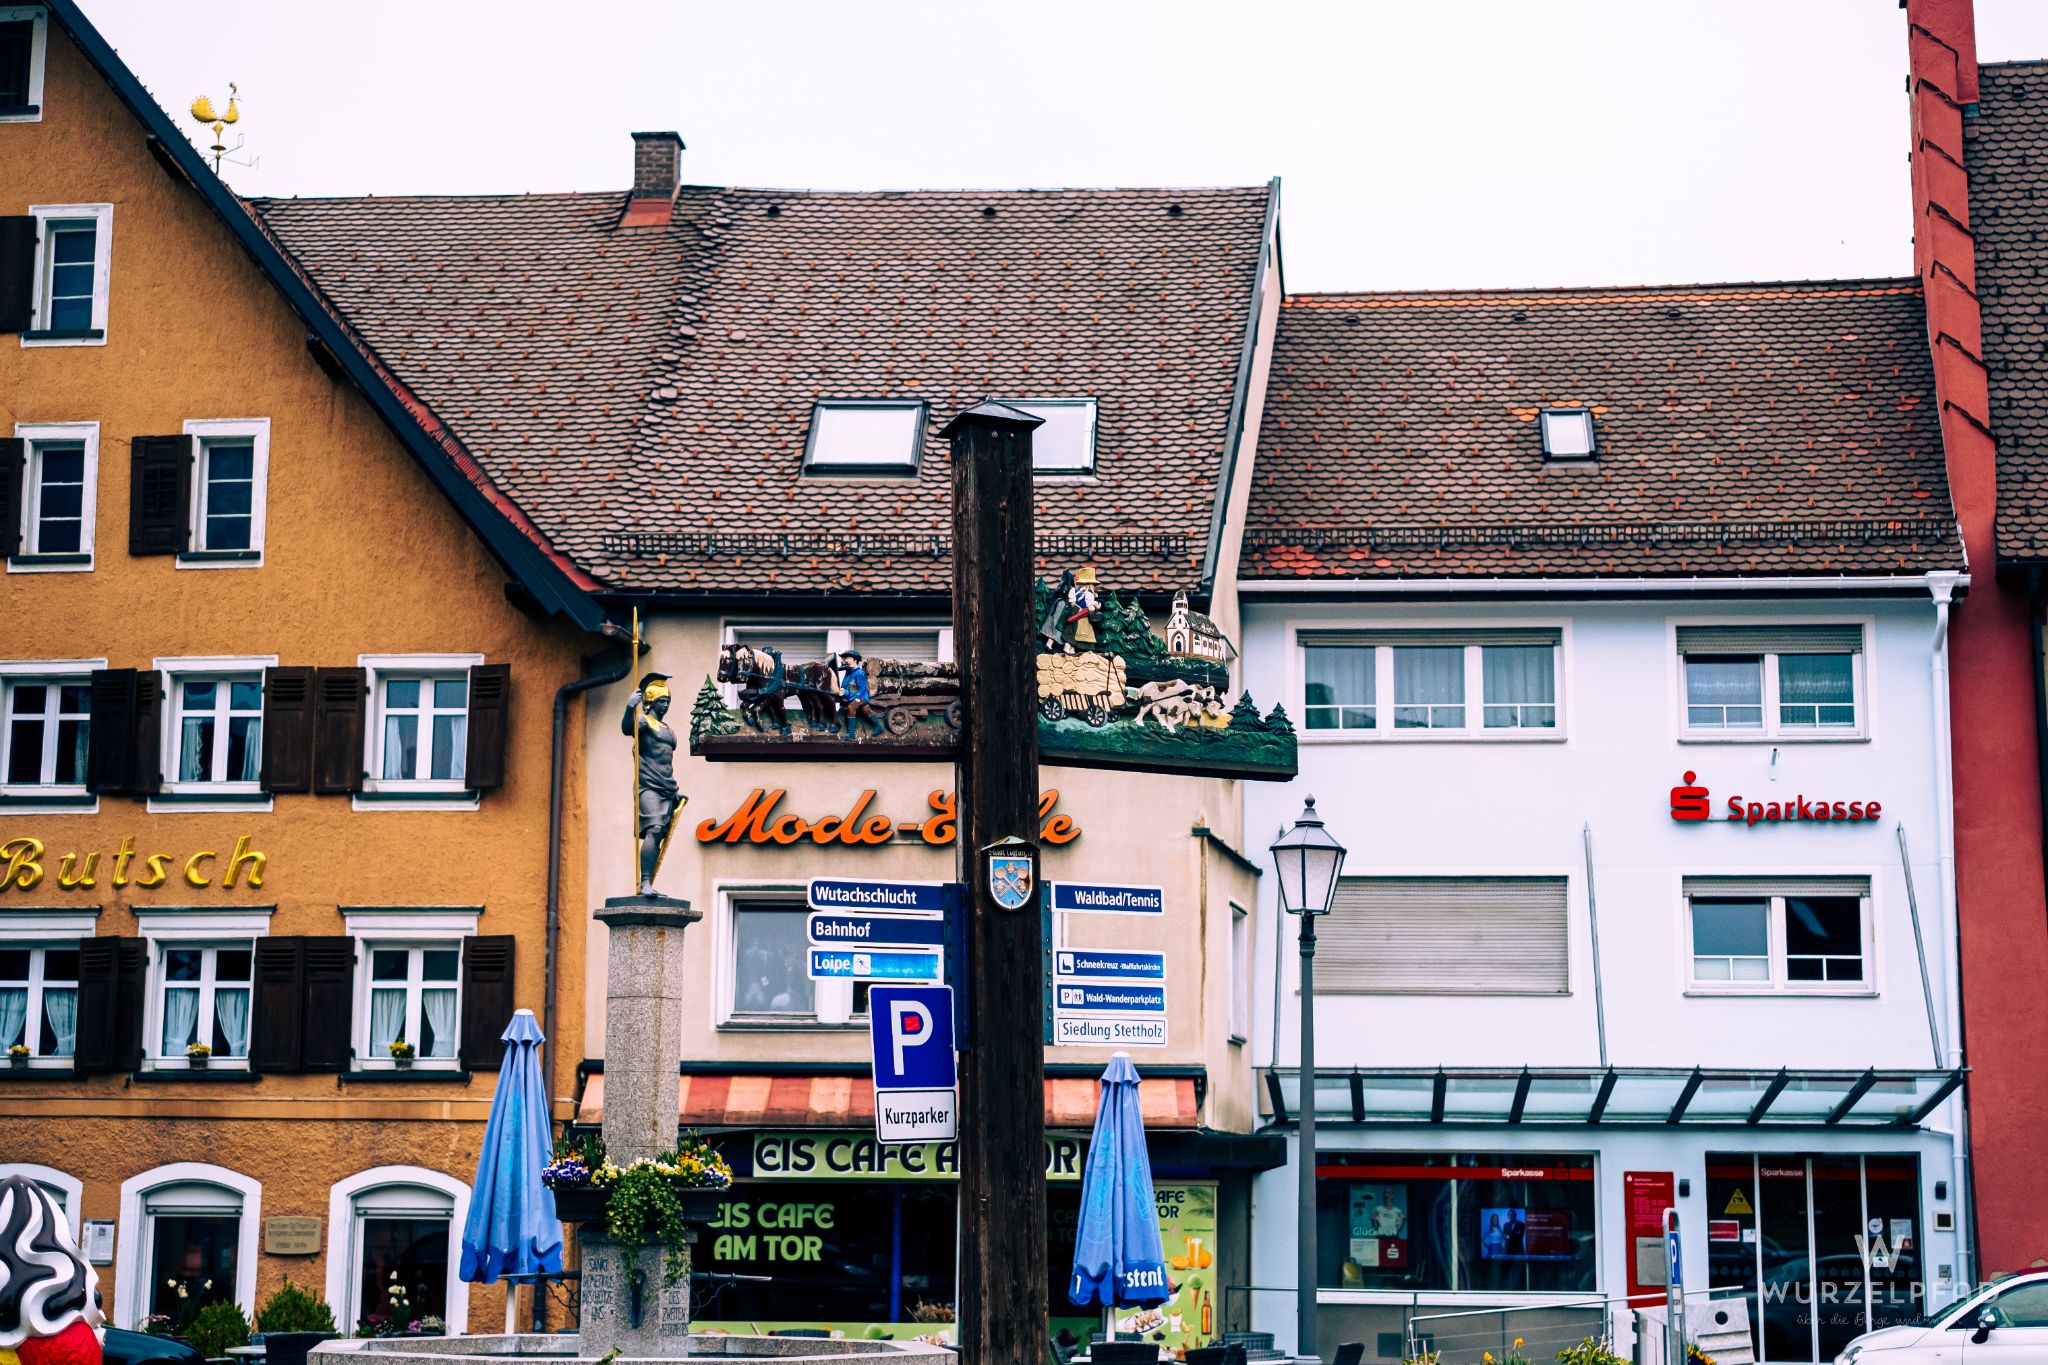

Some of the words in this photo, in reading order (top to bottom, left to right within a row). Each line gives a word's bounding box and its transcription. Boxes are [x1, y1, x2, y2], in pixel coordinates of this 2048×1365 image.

[1727, 794, 1881, 827] Sparkasse
[0, 835, 267, 892] Butsch
[815, 886, 917, 905] Wutachschlucht
[1074, 890, 1160, 908] Waldbad/Tennis
[815, 921, 871, 938] Bahnhof
[814, 955, 851, 973] Loipe
[1076, 959, 1119, 970] Schneekreuz
[1085, 993, 1161, 1005] Wald-Wanderparkplatz
[889, 999, 934, 1076] P
[1062, 1022, 1111, 1040] Siedlung
[1114, 1023, 1163, 1038] Stettholz
[884, 1106, 949, 1128] Kurzparker
[755, 1137, 817, 1173] EIS
[825, 1138, 928, 1174] CAFE
[935, 1140, 961, 1174] A
[1502, 1168, 1544, 1177] Sparkasse
[1760, 1168, 1804, 1177] Sparkasse
[1154, 1190, 1185, 1204] AFE
[757, 1203, 834, 1229] CAFE
[1156, 1205, 1179, 1218] OR
[713, 1234, 757, 1260] AM
[763, 1235, 823, 1261] TOR
